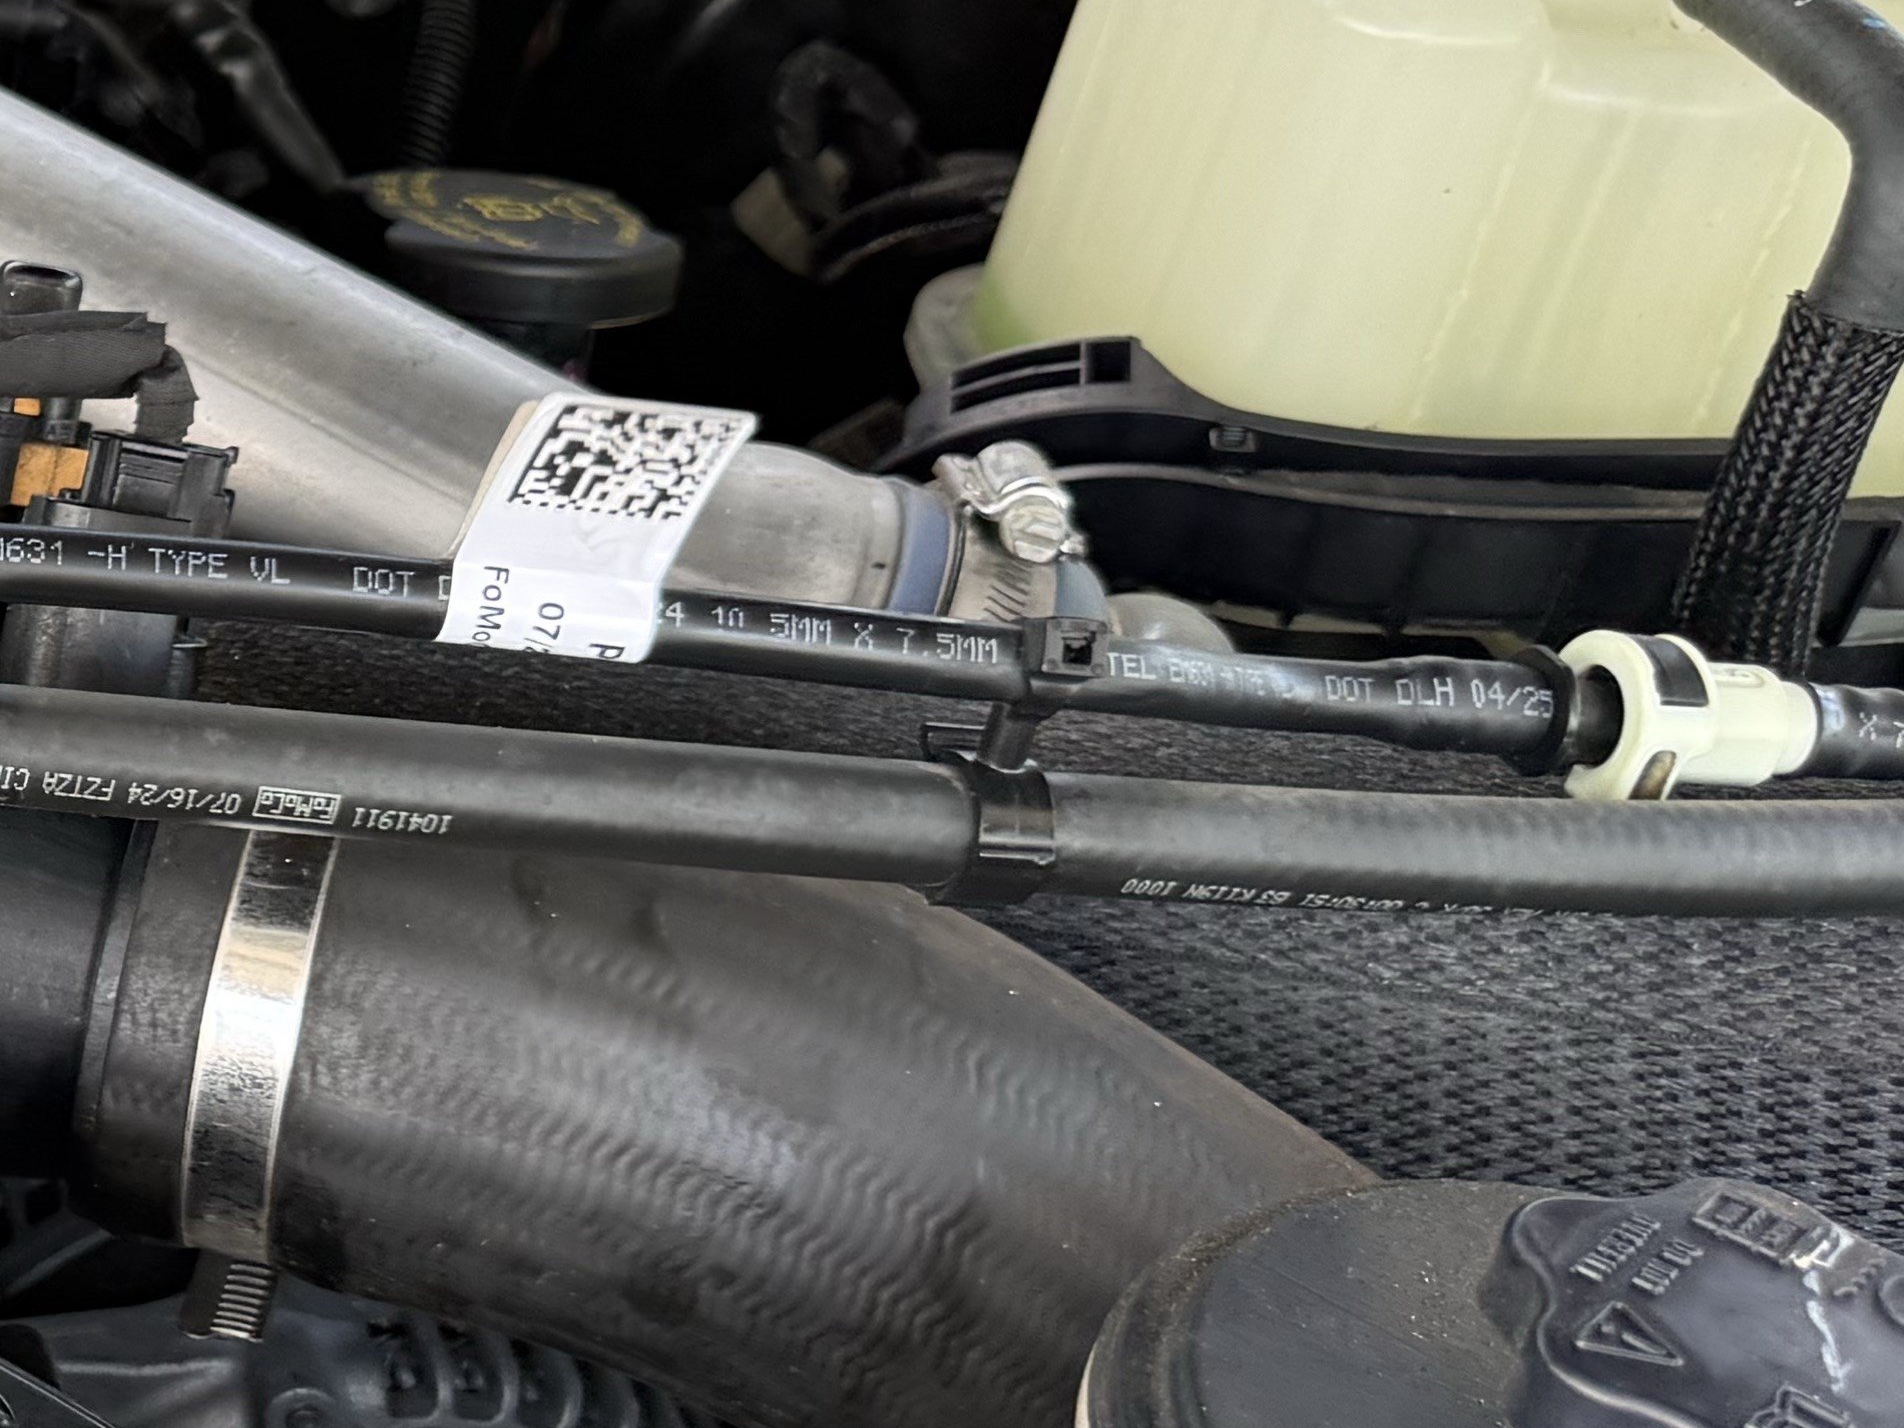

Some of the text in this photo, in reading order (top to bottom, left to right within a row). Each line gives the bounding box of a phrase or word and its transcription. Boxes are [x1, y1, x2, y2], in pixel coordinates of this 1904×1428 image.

[148, 547, 229, 579] TYPE
[352, 567, 415, 596] DOT
[471, 565, 511, 648] FoMo
[895, 626, 1000, 665] 7.5MM
[1471, 678, 1555, 719] 04/25
[127, 781, 242, 815] 07/16/24
[353, 805, 453, 835] 1041911
